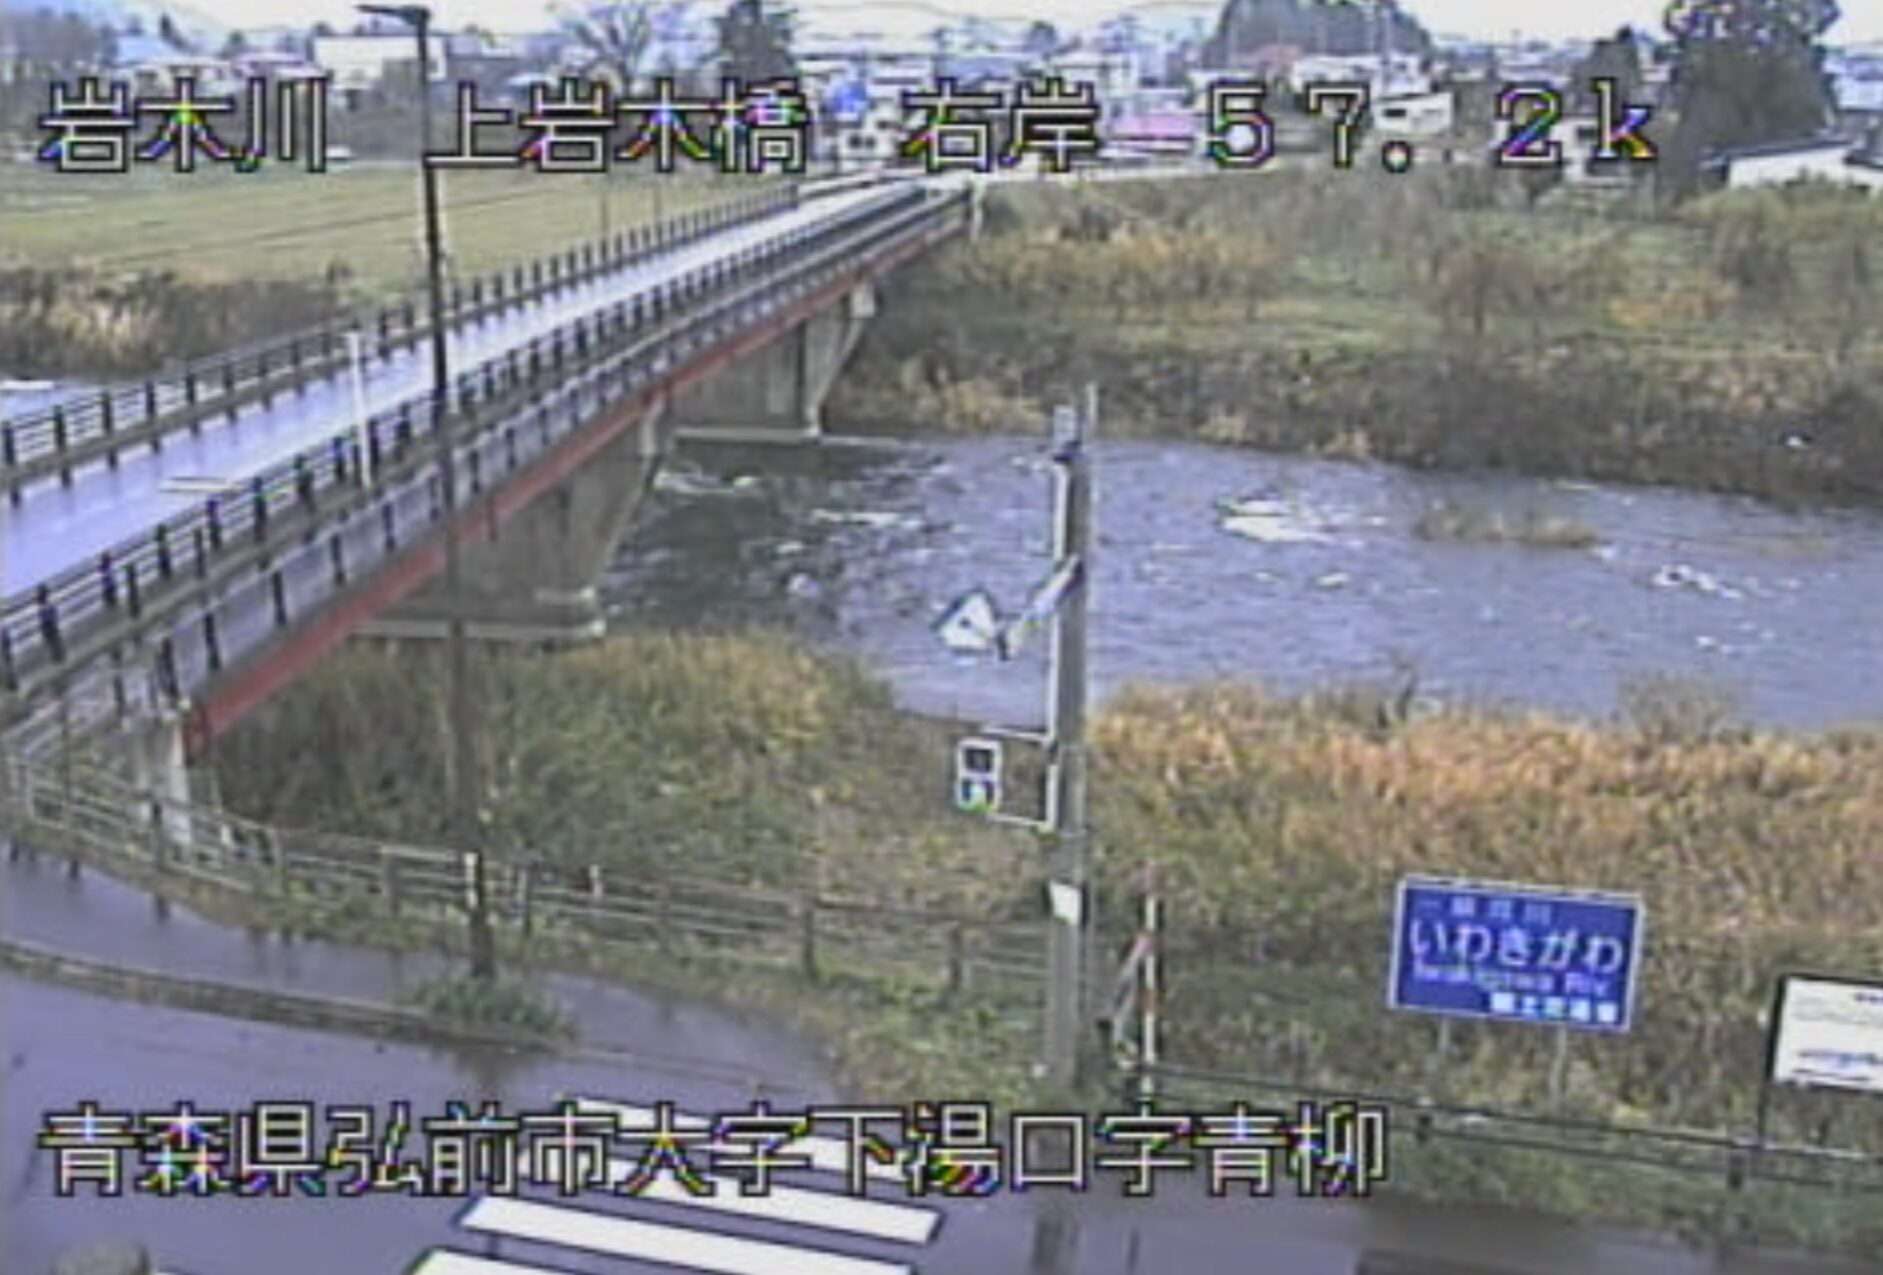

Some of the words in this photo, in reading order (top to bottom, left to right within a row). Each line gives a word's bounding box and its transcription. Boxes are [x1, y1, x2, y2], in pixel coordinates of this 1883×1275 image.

[1409, 919, 1623, 974] いわきがわ
